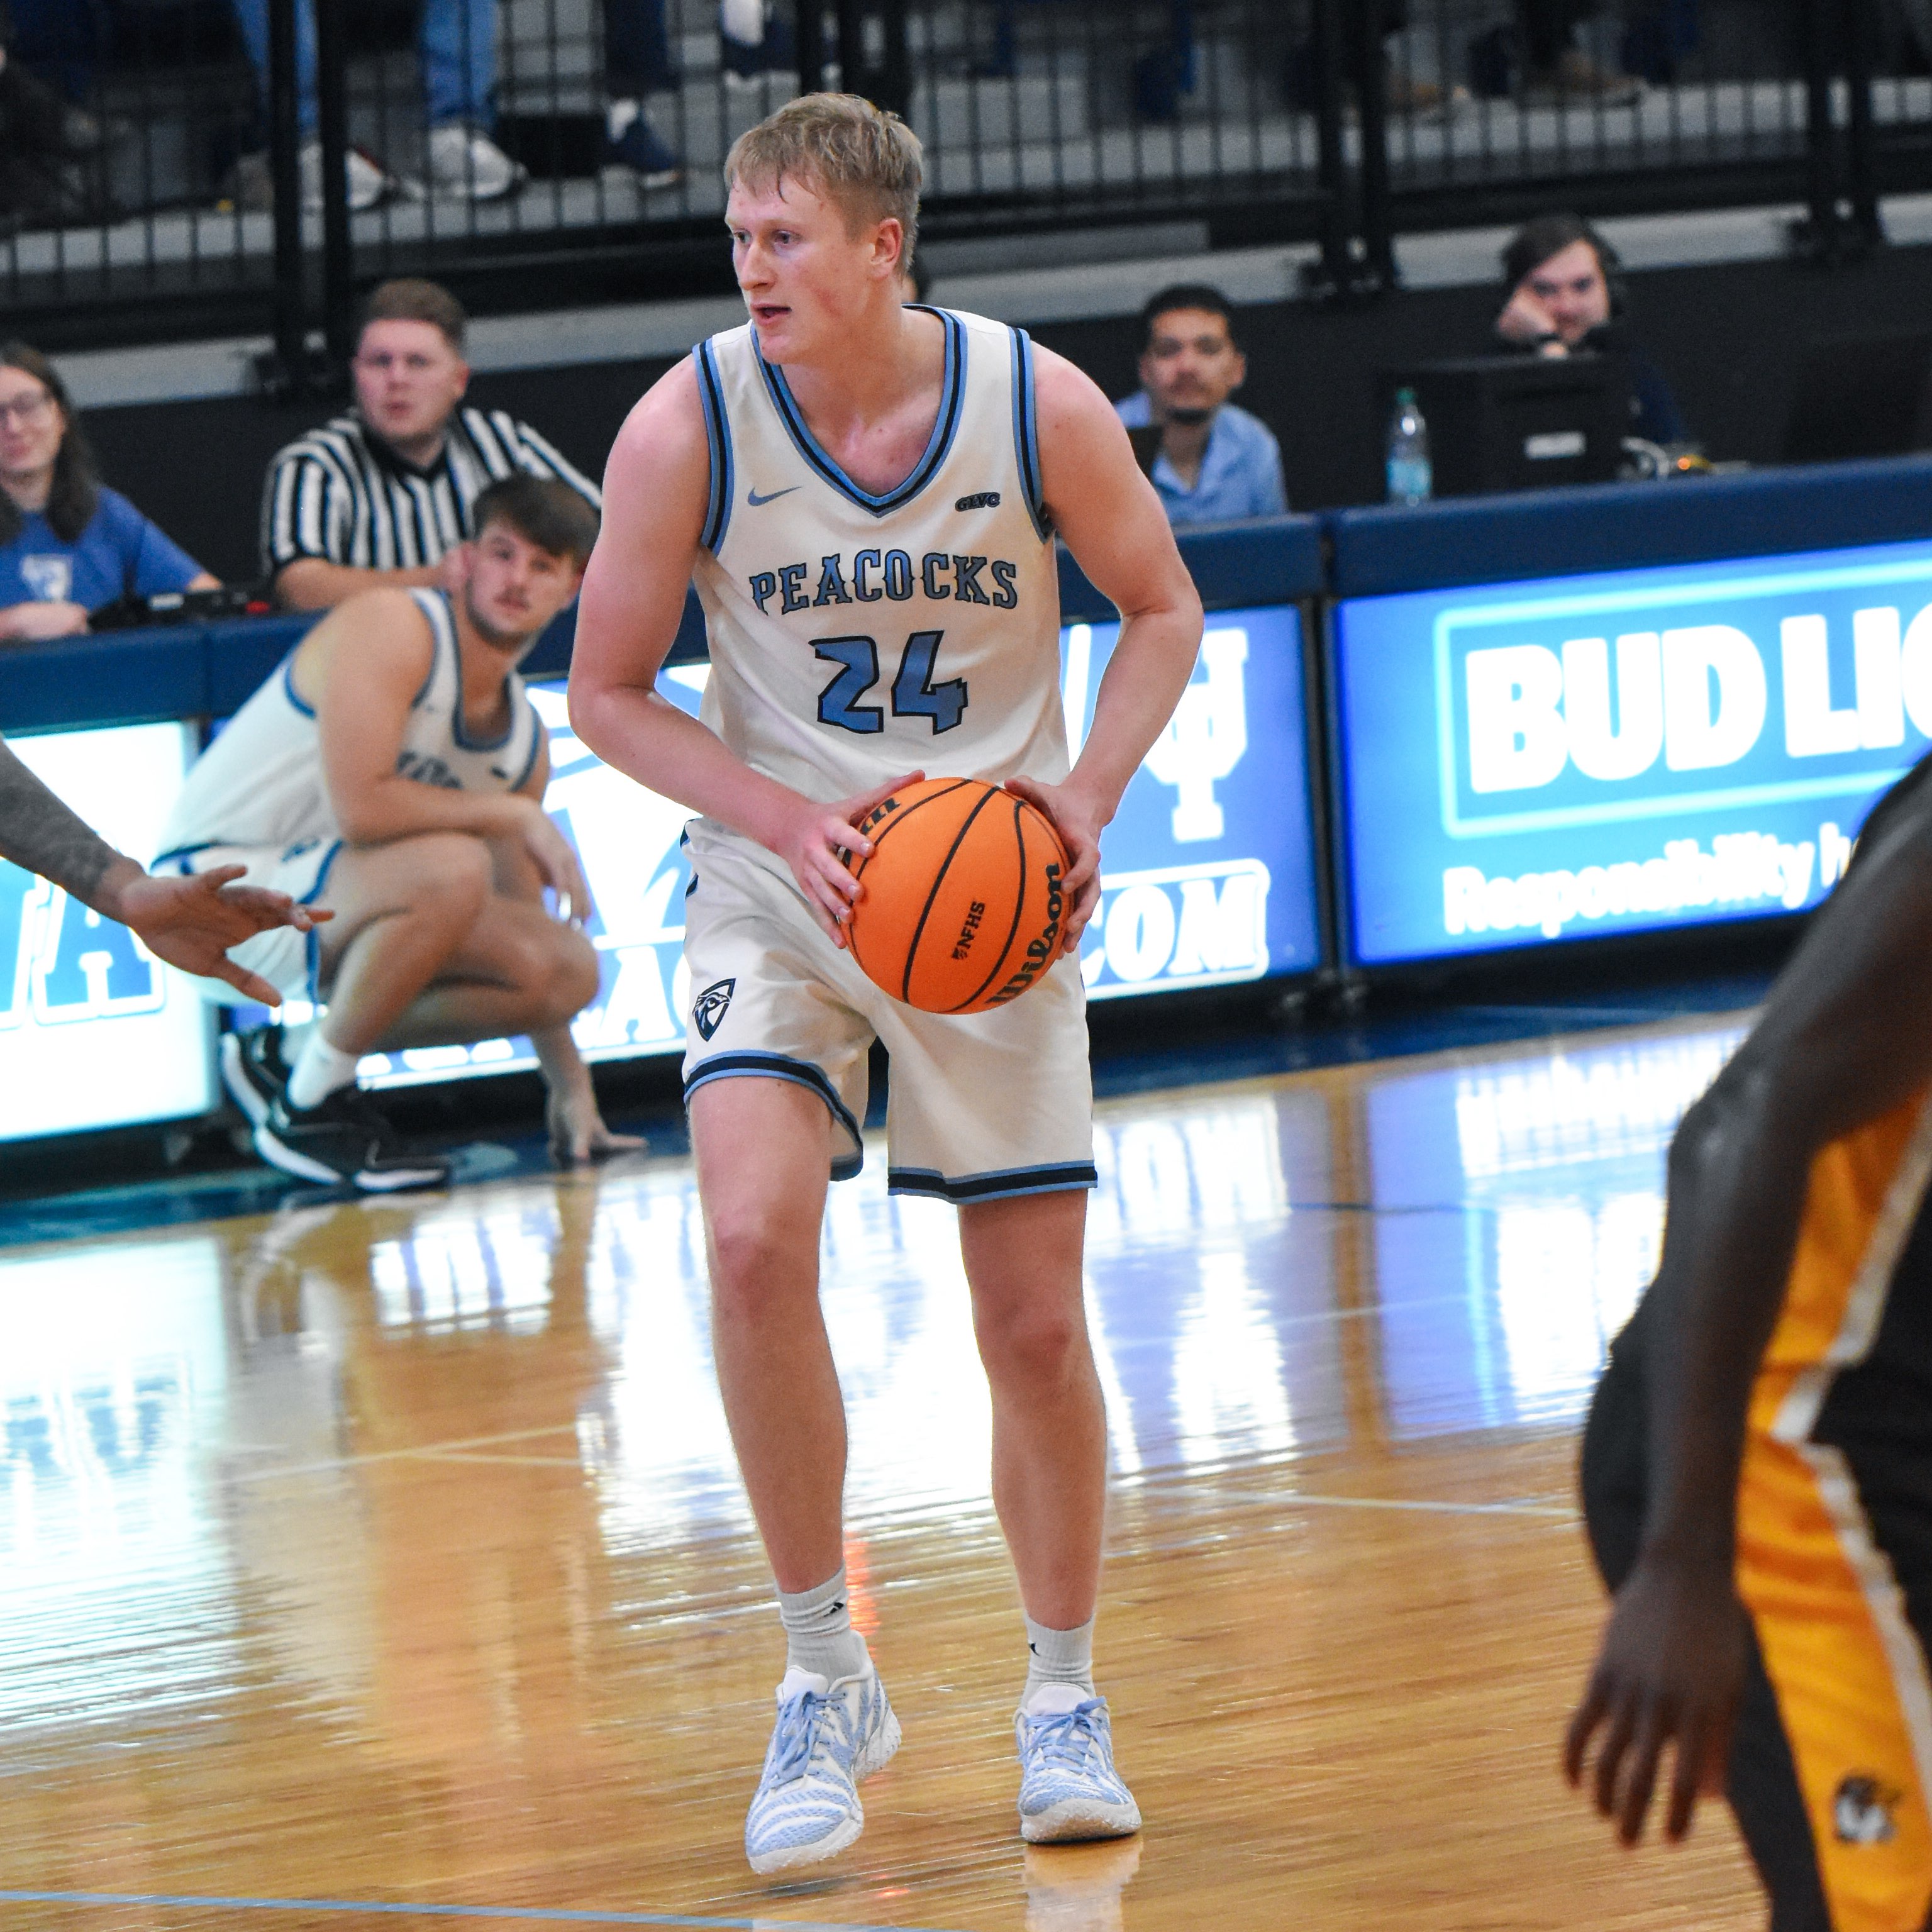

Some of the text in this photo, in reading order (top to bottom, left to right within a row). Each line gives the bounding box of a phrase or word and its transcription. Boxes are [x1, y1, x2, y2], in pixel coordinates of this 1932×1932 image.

[749, 548, 1018, 616] PEACOCKS
[808, 630, 969, 736] 24
[1466, 625, 1767, 794] BUD
[955, 901, 985, 952] NFHS
[984, 863, 1063, 1004] Wilson
